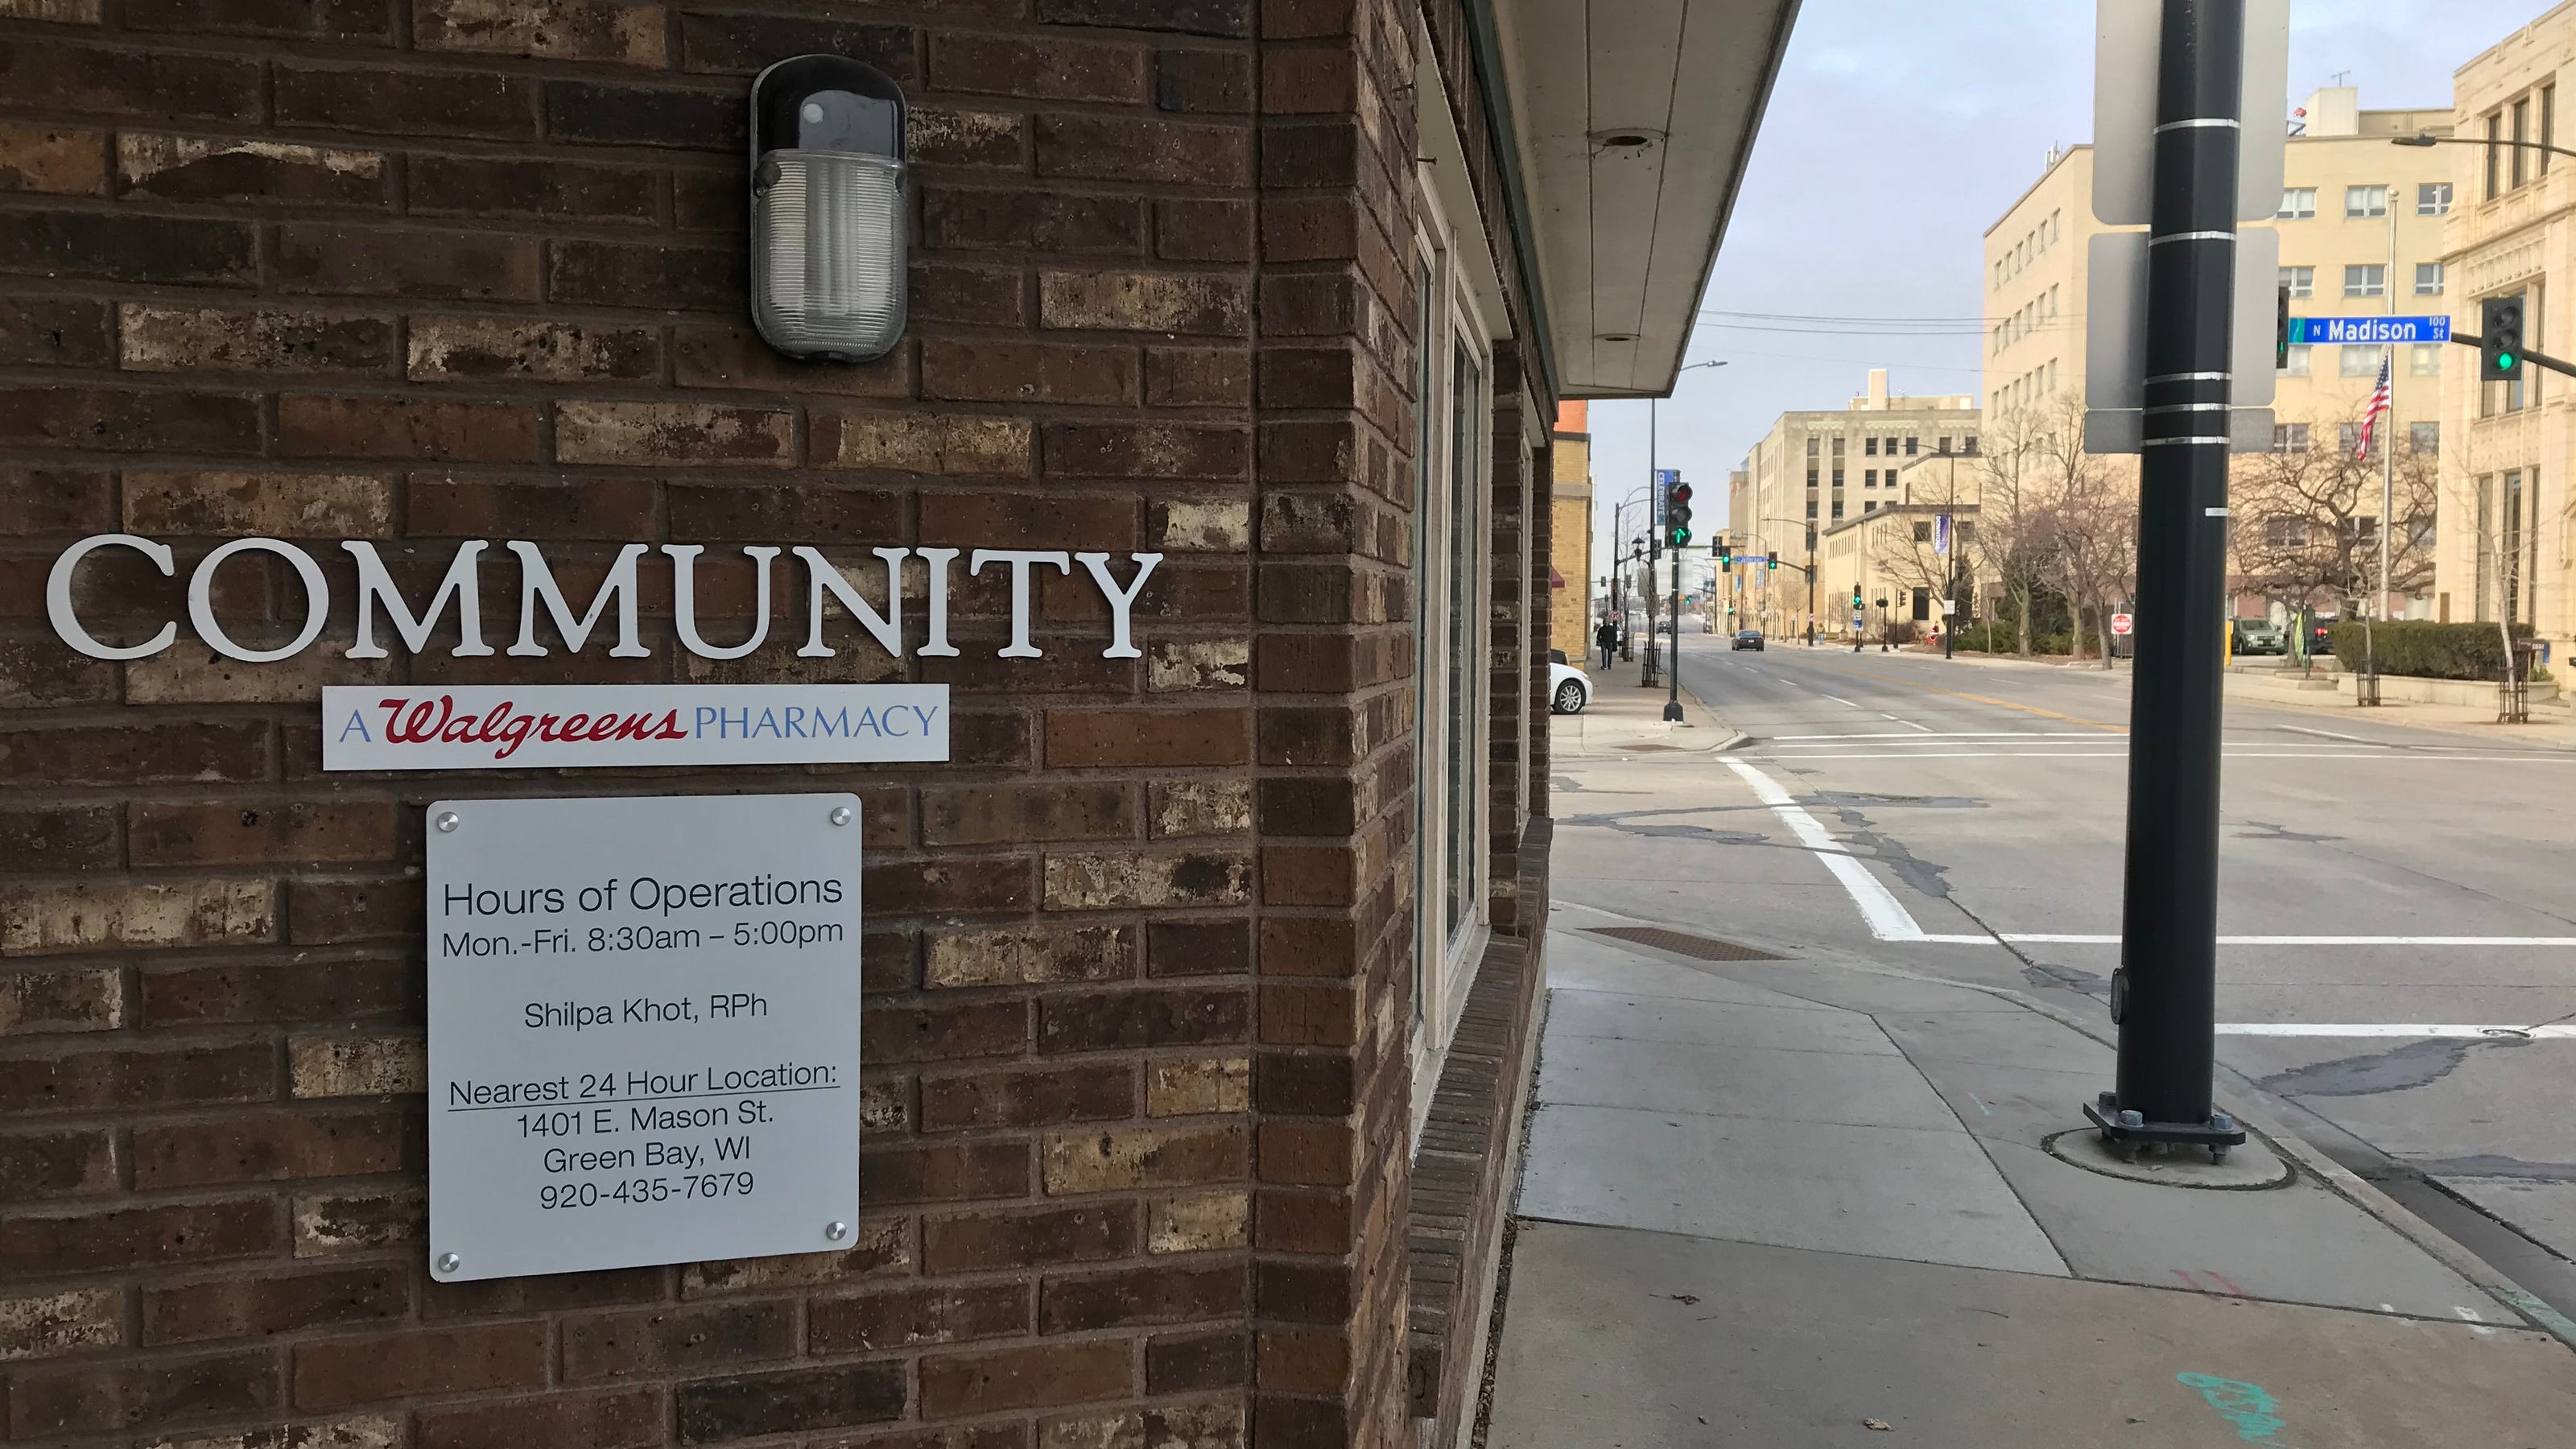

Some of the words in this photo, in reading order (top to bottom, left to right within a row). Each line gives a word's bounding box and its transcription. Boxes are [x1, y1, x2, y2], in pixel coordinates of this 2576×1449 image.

[2313, 324, 2321, 336] N
[2329, 319, 2416, 341] Madison
[2433, 328, 2445, 339] St
[2429, 317, 2446, 326] 100
[46, 533, 1164, 663] COMMUNITY
[339, 708, 372, 743] A
[378, 694, 688, 760] Walgreens
[696, 704, 939, 739] PHARMACY
[444, 882, 565, 916] Hours
[578, 878, 618, 912] of
[630, 873, 843, 918] Operations
[443, 928, 576, 958] Mon.-Fri.
[588, 925, 700, 952] 8:30am
[733, 920, 843, 950] 5:00pm
[524, 1001, 614, 1032] Shilpa
[623, 997, 699, 1024] Khot,
[710, 993, 767, 1019] RPh
[449, 1076, 569, 1105] Nearest
[579, 1072, 617, 1099] 24
[627, 1070, 698, 1096] Hour
[708, 1062, 836, 1091] Location:
[516, 1112, 581, 1138] 1401
[594, 1108, 619, 1134] E.
[631, 1105, 729, 1132] Mason
[737, 1099, 774, 1125] St.
[543, 1148, 635, 1174] Green
[646, 1141, 704, 1170] Bay,
[714, 1135, 749, 1162] WI
[540, 1171, 754, 1210] 920-435-7679
